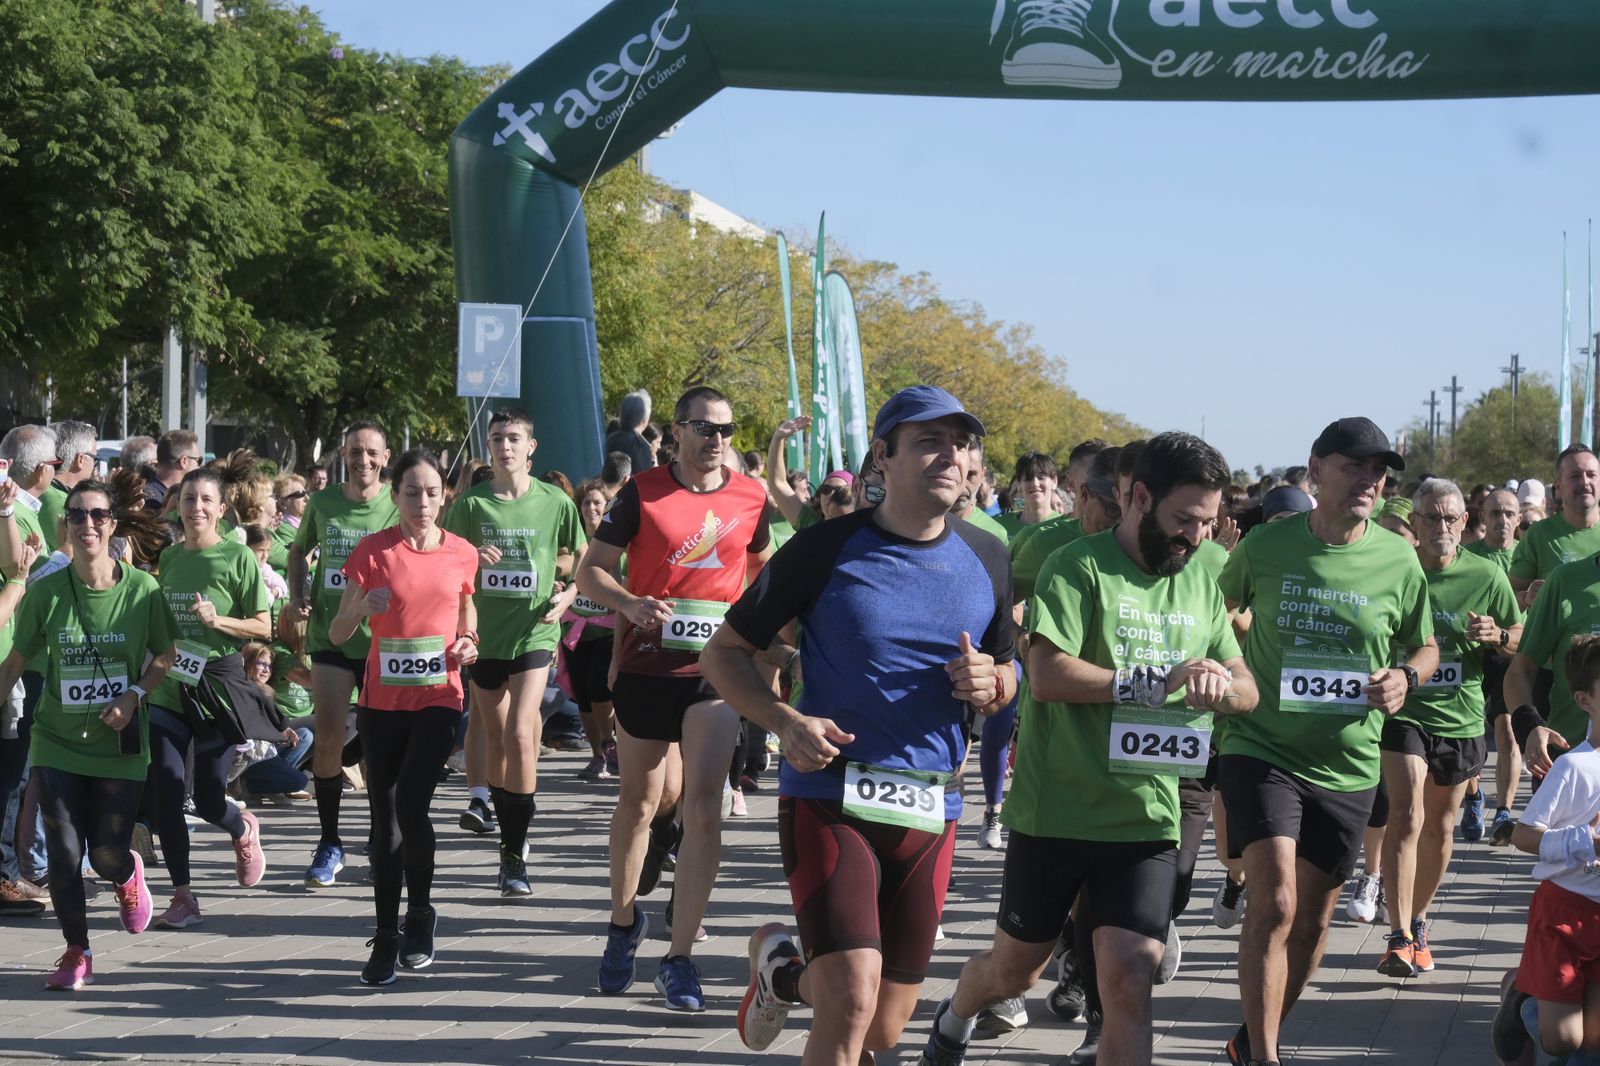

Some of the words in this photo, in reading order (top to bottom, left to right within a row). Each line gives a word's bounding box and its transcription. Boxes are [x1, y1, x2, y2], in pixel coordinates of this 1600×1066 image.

[1151, 48, 1223, 78] en
[1226, 32, 1429, 79] marcha
[554, 7, 691, 129] aecc
[595, 98, 635, 130] Contra
[635, 84, 647, 100] el
[647, 54, 687, 90] Cáncer
[474, 315, 505, 353] P
[326, 526, 337, 535] En
[481, 527, 493, 536] En
[496, 527, 536, 537] marcha
[326, 537, 356, 546] contra
[335, 546, 352, 556] cán
[482, 537, 513, 546] contra
[500, 548, 527, 557] ncer
[487, 574, 532, 588] 0140
[171, 591, 209, 602] marca
[1281, 581, 1302, 596] En
[1307, 586, 1368, 606] marcha
[1119, 602, 1140, 620] En
[1279, 599, 1331, 617] contra
[671, 619, 722, 639] 029
[1116, 625, 1164, 644] conta
[1277, 614, 1290, 628] el
[1295, 617, 1352, 636] cáncer
[58, 632, 74, 644] En
[1114, 641, 1130, 657] el
[1134, 644, 1188, 663] cáncer
[173, 653, 201, 675] 245
[387, 656, 442, 674] 0296
[1431, 667, 1457, 683] 90
[68, 681, 123, 701] 0242
[1291, 675, 1361, 699] 0343
[1120, 731, 1200, 760] 0243
[856, 777, 936, 812] 0239
